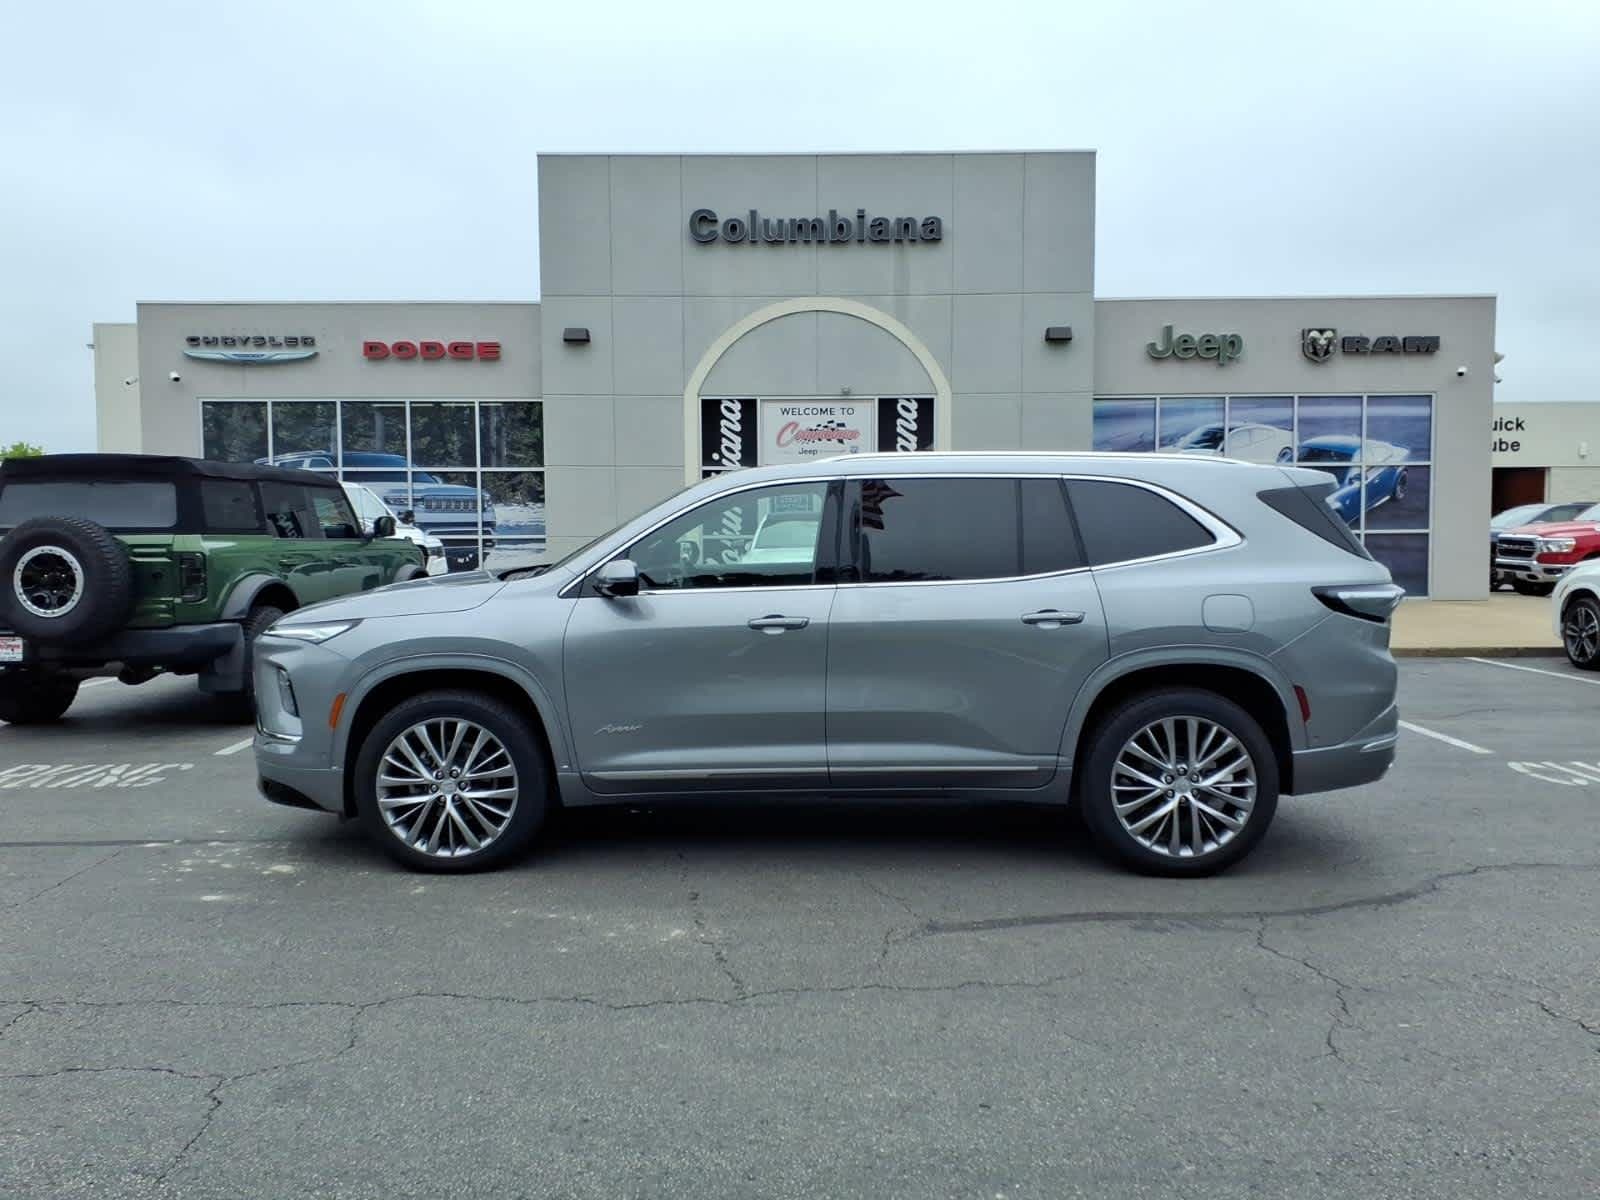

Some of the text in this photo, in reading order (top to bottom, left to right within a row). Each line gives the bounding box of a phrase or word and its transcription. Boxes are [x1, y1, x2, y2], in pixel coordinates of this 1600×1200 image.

[689, 208, 943, 244] Columbiana
[186, 335, 316, 347] CHRYSLER
[363, 341, 502, 360] DODGE
[1147, 325, 1243, 366] Jeep
[1341, 335, 1440, 355] RAM
[780, 407, 855, 416] WELCOME TO
